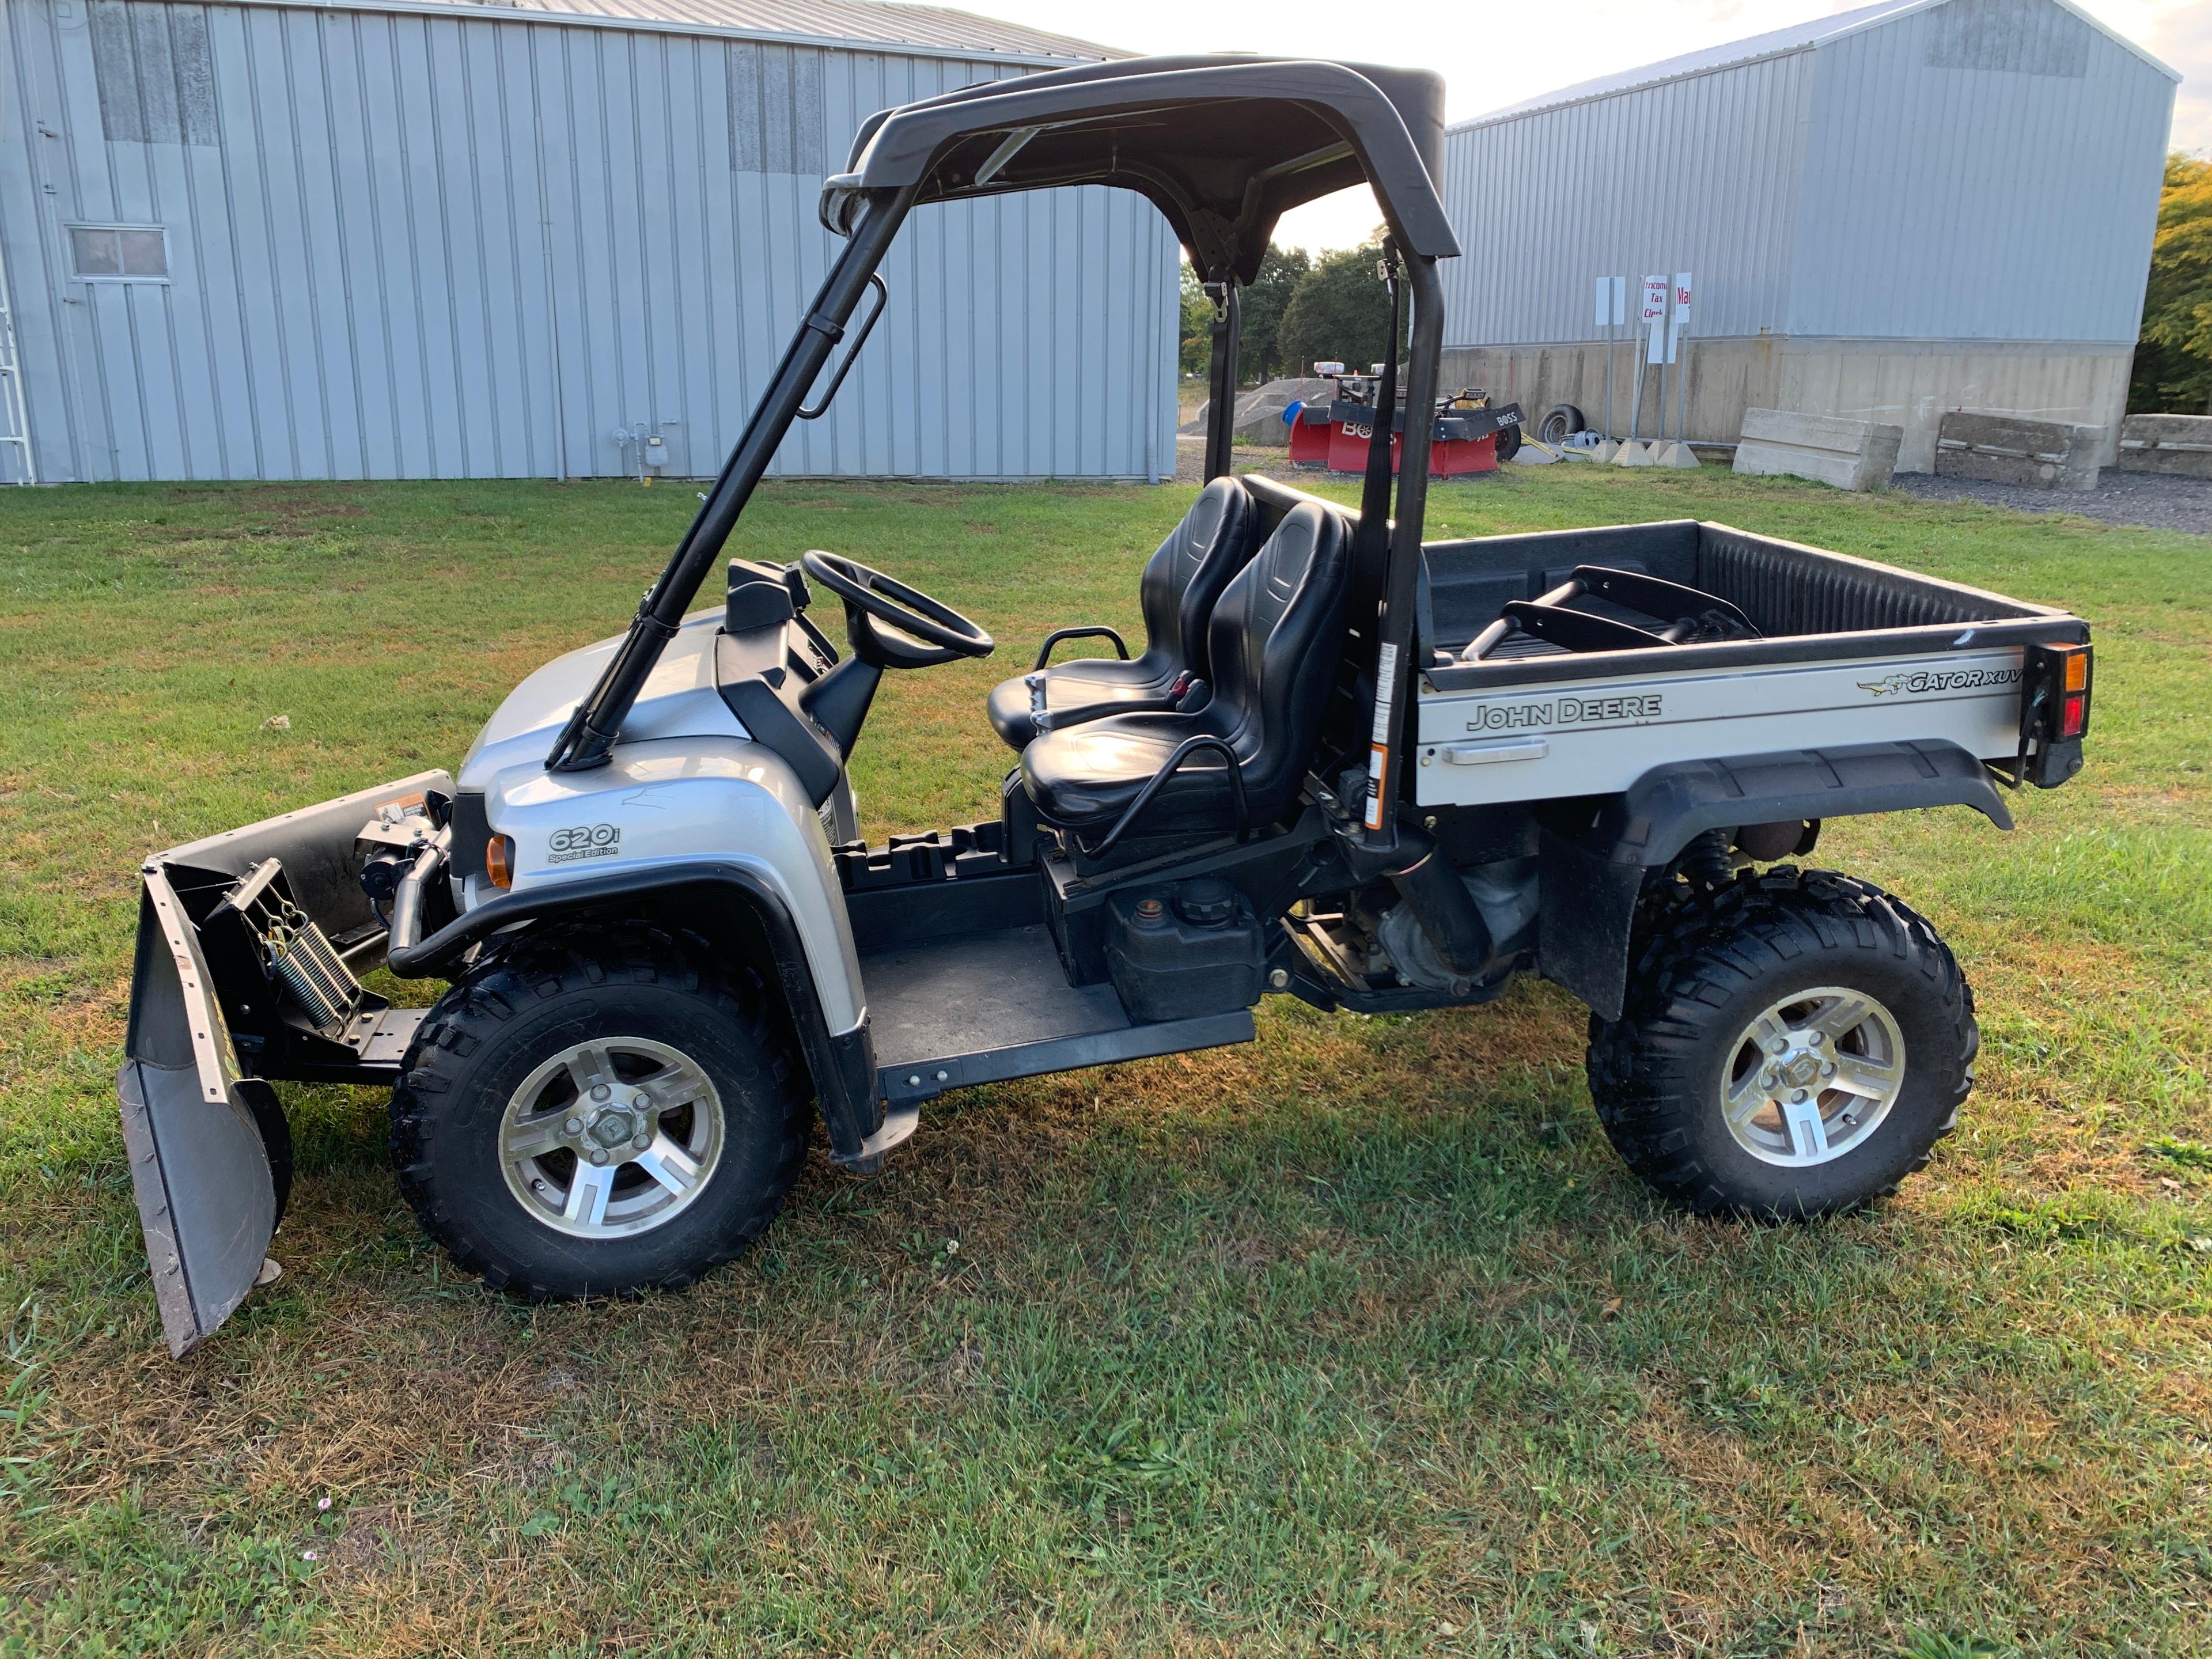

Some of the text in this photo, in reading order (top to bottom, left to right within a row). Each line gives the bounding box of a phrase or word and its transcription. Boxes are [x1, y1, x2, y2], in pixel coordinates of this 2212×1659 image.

[1651, 293, 1663, 302] Tax
[1496, 411, 1518, 426] BOSS
[1907, 668, 2023, 692] GATOR XUV
[1467, 695, 1662, 731] JOHN DEERE
[549, 823, 620, 852] 620i
[548, 847, 618, 863] Special Edition
